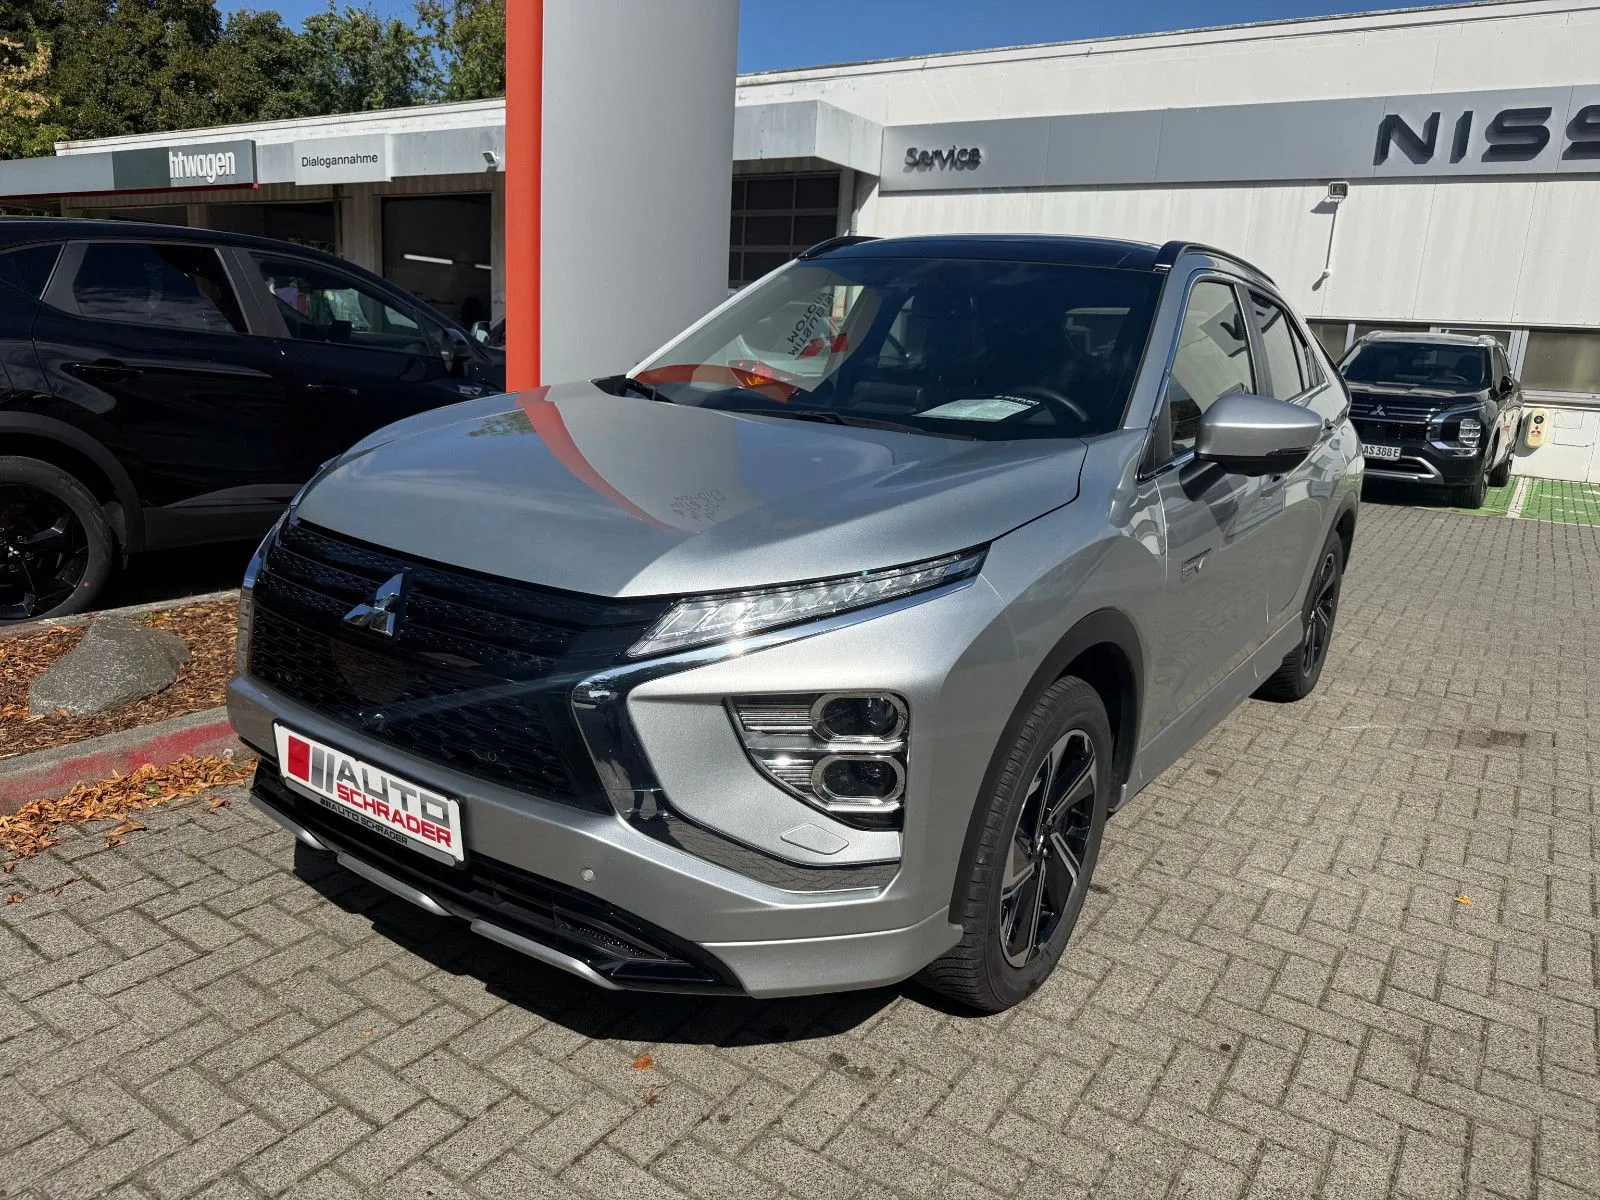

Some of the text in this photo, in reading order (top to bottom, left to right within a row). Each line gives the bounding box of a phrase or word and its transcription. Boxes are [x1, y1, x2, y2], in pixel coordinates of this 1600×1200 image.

[169, 151, 236, 184] htwagen
[301, 153, 378, 168] Dialogannahme
[903, 145, 981, 169] Service
[336, 759, 451, 829] AUTO
[331, 803, 408, 845] AUTO SCHRADER
[336, 782, 452, 848] SCHRADER
